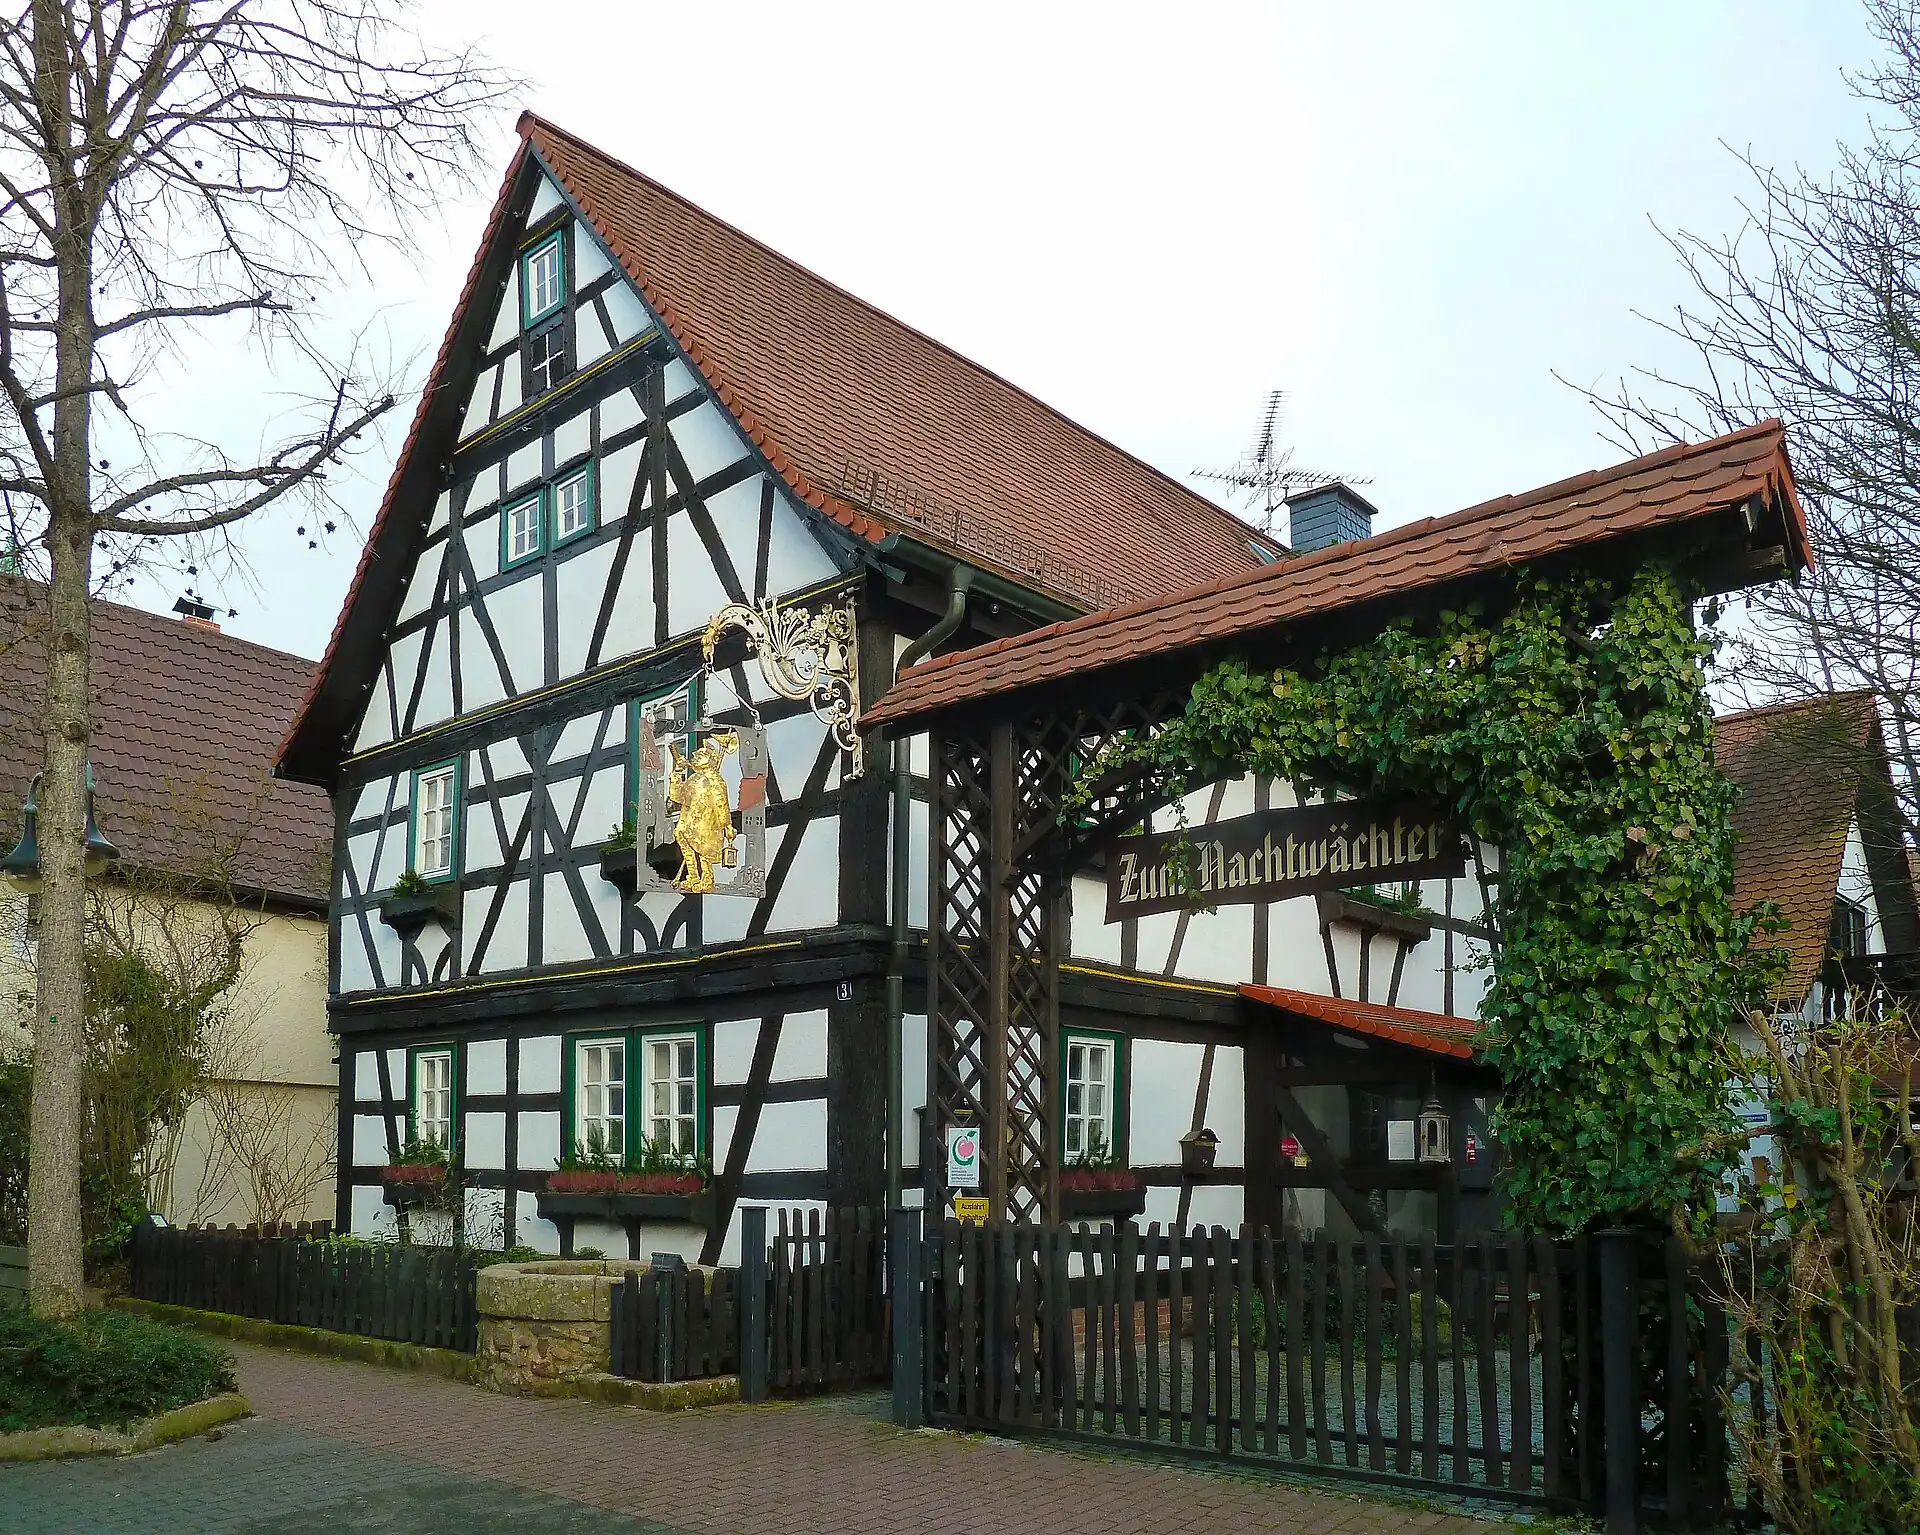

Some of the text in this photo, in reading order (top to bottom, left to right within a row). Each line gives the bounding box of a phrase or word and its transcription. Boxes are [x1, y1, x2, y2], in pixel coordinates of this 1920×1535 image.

[1194, 816, 1441, 892] Nachtwächter
[841, 983, 847, 998] 3
[961, 1202, 985, 1210] Ausfahrt
